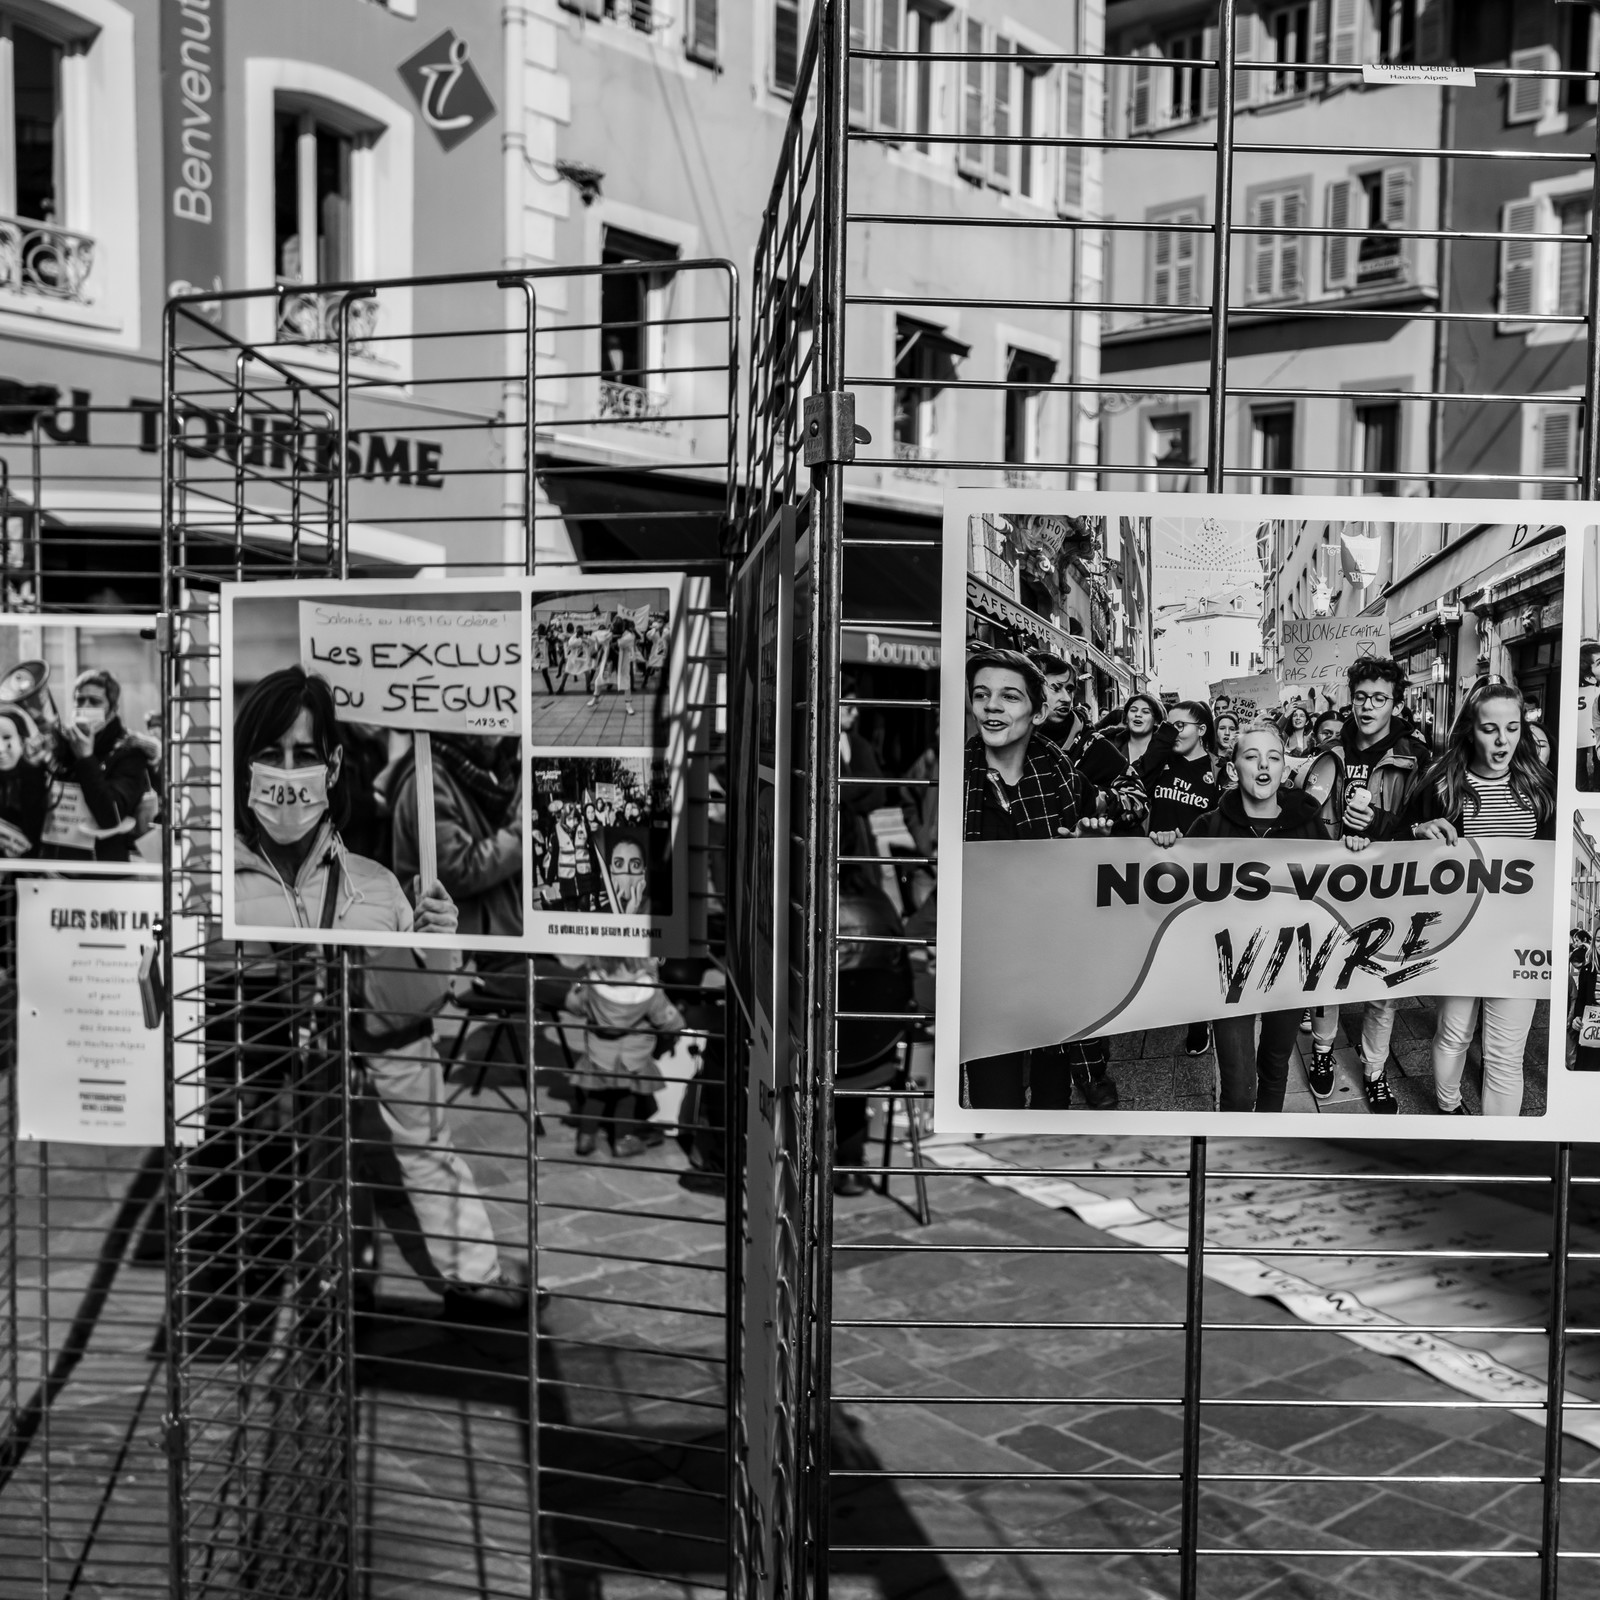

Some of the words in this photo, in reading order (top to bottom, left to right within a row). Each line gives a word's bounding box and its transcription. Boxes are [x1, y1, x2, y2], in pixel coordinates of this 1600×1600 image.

[130, 397, 443, 488] TOURISME
[1282, 621, 1335, 644] BRULONS
[1335, 623, 1350, 640] LE
[1350, 624, 1387, 637] CAPITAL
[310, 637, 362, 666] Les
[371, 642, 522, 668] EXCLUS
[1284, 666, 1307, 681] PAS
[1311, 663, 1334, 680] LE
[382, 675, 518, 714] SÉGUR
[261, 783, 311, 805] -183€
[1172, 776, 1193, 792] Fly
[1154, 784, 1210, 810] Emirates
[1096, 861, 1272, 907] NOUS
[1286, 858, 1535, 901] VOULONS
[50, 908, 87, 931] ELLES
[90, 909, 128, 931] SONT
[132, 911, 150, 930] LA
[632, 926, 640, 937] LA
[1213, 909, 1444, 1004] VIVRE
[1512, 969, 1538, 980] FOR
